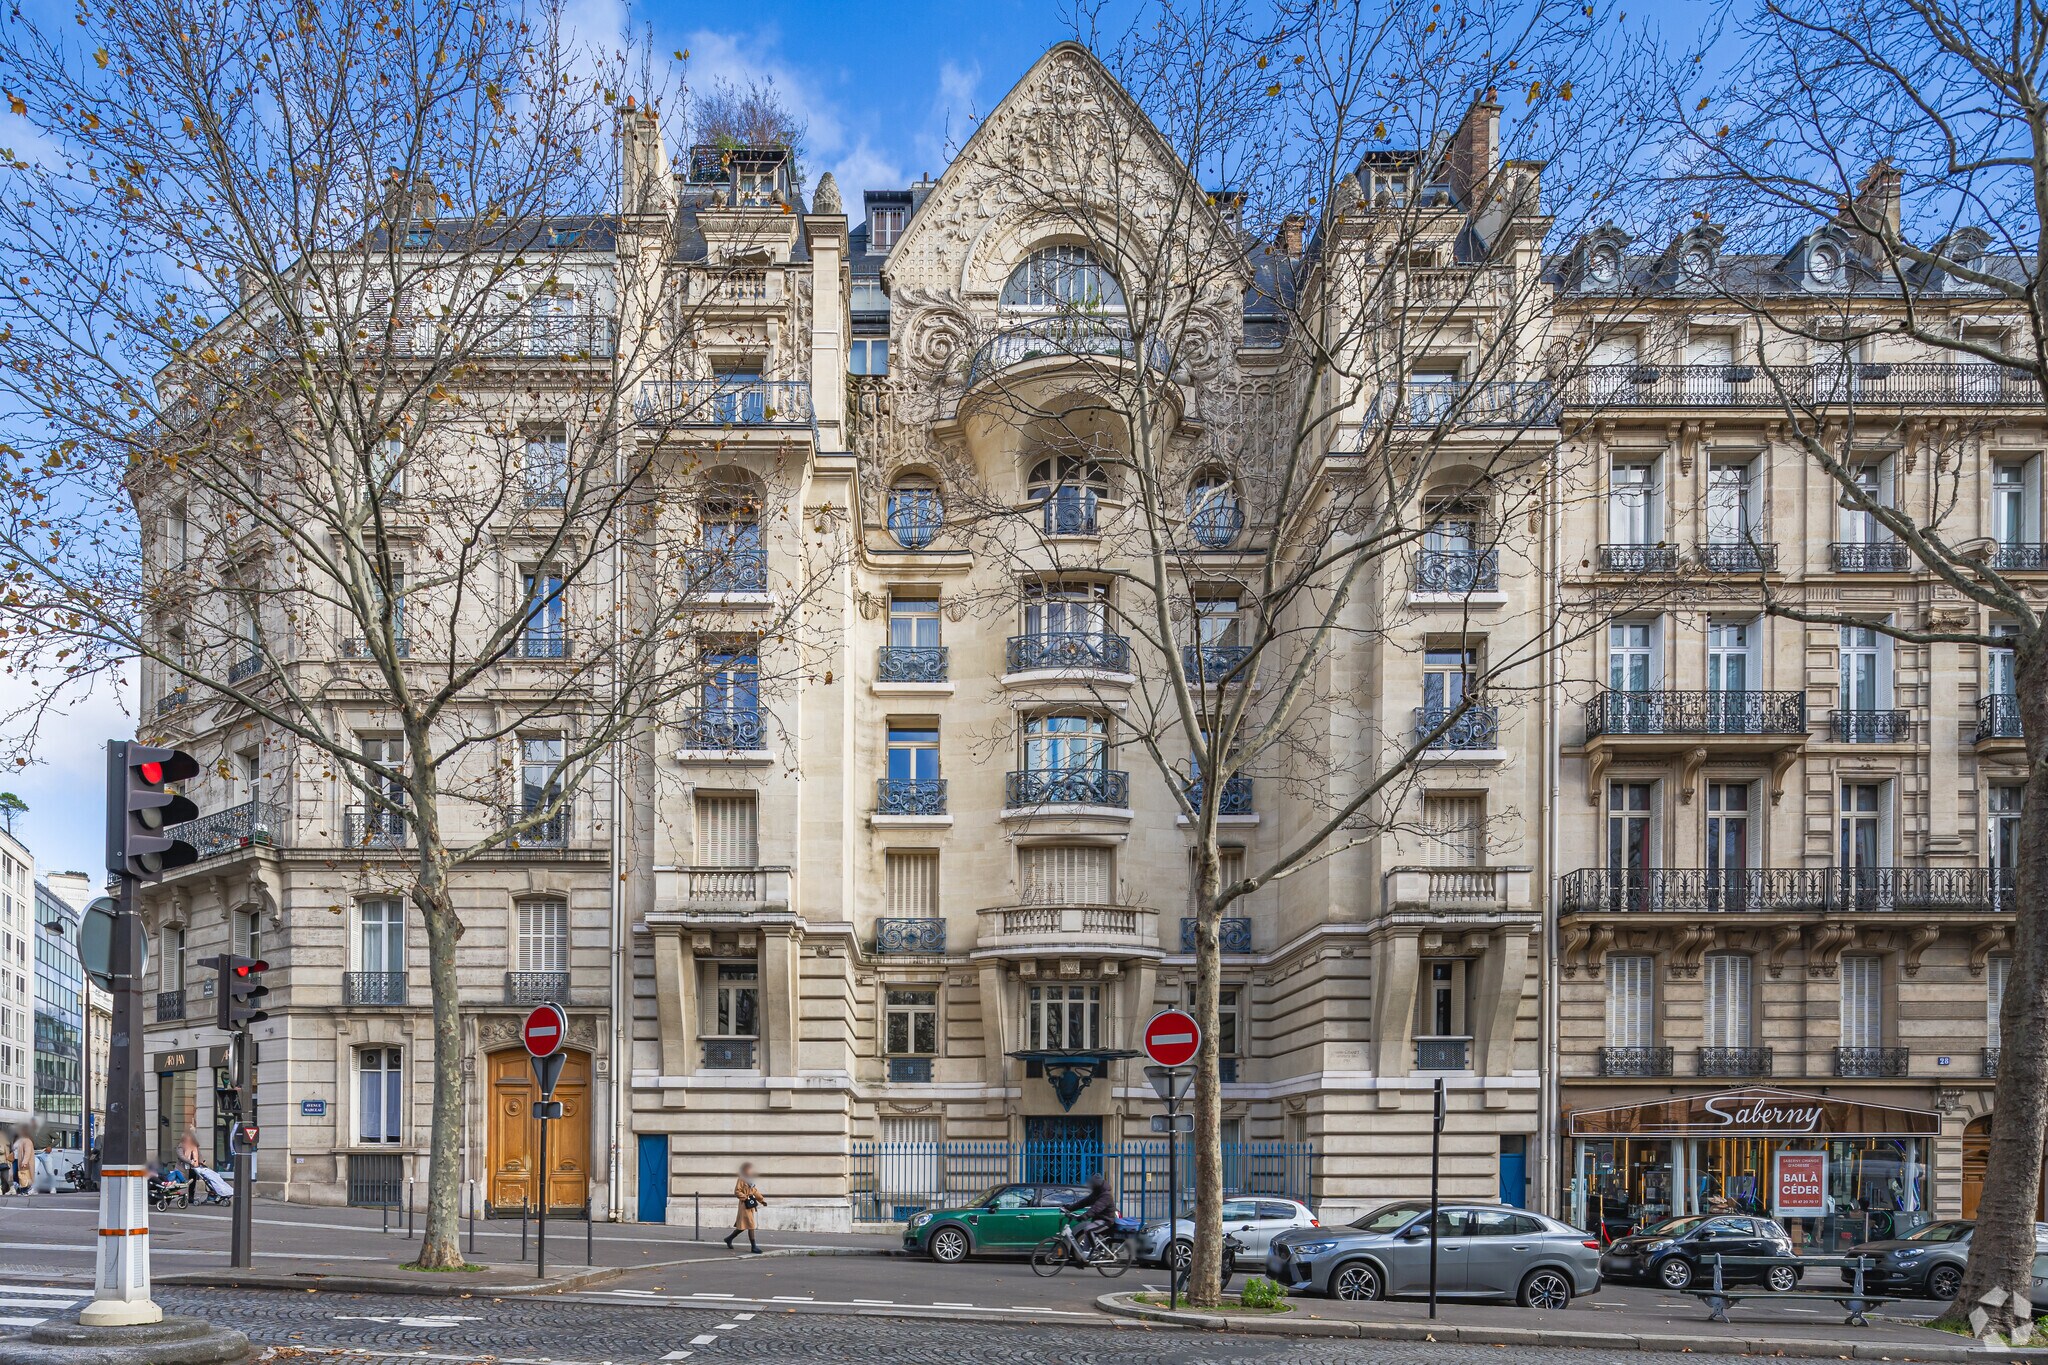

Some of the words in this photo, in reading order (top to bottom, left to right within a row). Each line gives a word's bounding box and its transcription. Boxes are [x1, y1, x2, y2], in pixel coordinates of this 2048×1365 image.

[1939, 1057, 1949, 1065] 28
[1705, 1097, 1823, 1132] Saberny
[1783, 1173, 1808, 1182] BAIL
[1810, 1171, 1818, 1182] À
[1782, 1183, 1819, 1195] CÉDER
